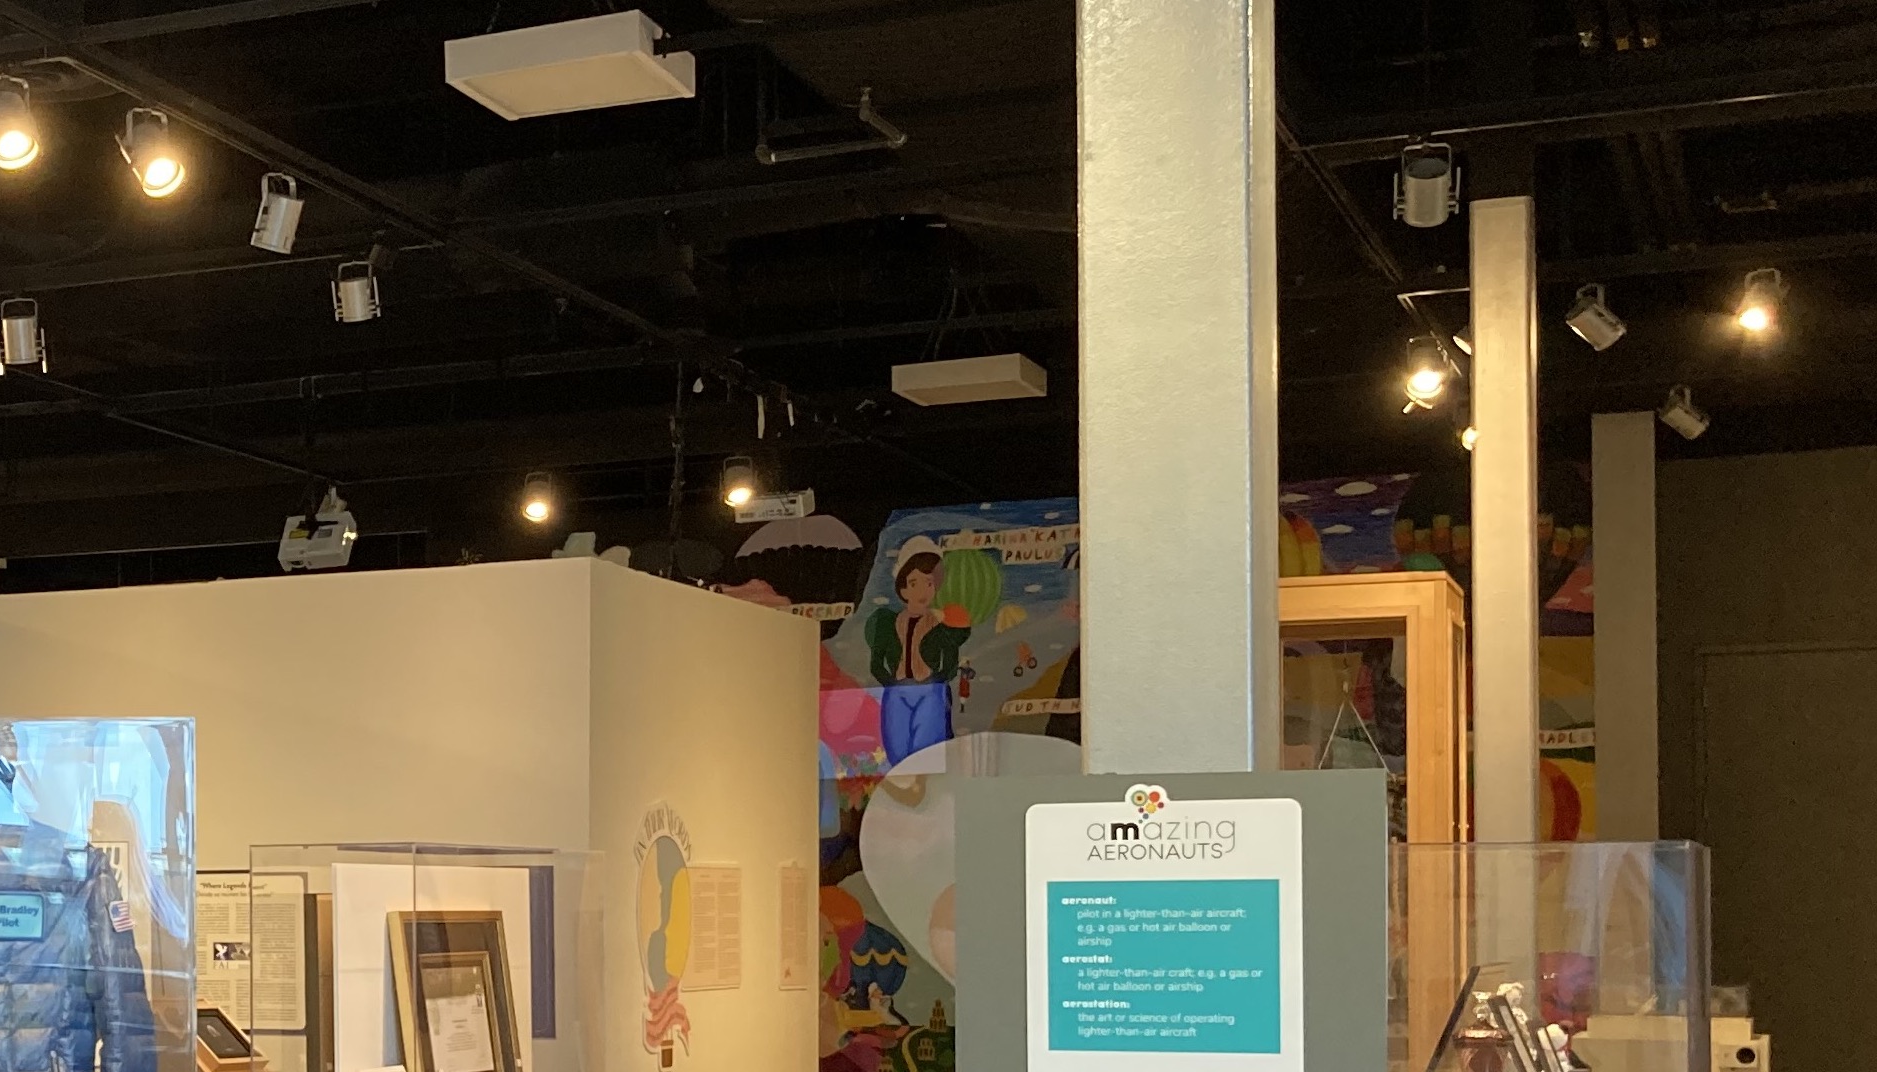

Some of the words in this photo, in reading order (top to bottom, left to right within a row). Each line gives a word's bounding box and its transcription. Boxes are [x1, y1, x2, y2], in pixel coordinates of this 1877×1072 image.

[1086, 816, 1236, 853] amazing
[1087, 843, 1223, 861] AERONAUTS
[1061, 896, 1117, 905] aeronaut:
[0, 904, 39, 916] Bradley
[1077, 908, 1100, 920] pilot
[1102, 909, 1112, 918] in
[1114, 910, 1121, 918] a
[1123, 909, 1203, 920] lighter-than-air
[1206, 908, 1247, 919] aircraft;
[1077, 924, 1095, 934] e.g.
[1098, 924, 1105, 932] a
[1107, 924, 1126, 934] gas
[1128, 924, 1140, 932] or
[1142, 922, 1160, 932] hot
[1163, 923, 1176, 932] air
[1178, 922, 1218, 932] balloon
[1219, 923, 1232, 932] or
[1077, 936, 1112, 947] airship
[1061, 954, 1113, 963] aerostat:
[1078, 969, 1084, 977] a
[1086, 968, 1165, 979] lighter-than-air
[1168, 967, 1195, 978] craft;
[1197, 969, 1216, 980] e.g.
[1219, 969, 1226, 978] a
[1228, 969, 1249, 980] gas
[1250, 969, 1263, 978] or
[1078, 981, 1095, 991] hot
[1097, 981, 1110, 991] air
[1113, 981, 1151, 991] balloon
[1154, 983, 1165, 991] or
[1167, 982, 1204, 993] airship
[1062, 1000, 1131, 1009] aerostation:
[1078, 1012, 1095, 1022] the
[1097, 1013, 1112, 1022] art
[1115, 1014, 1126, 1022] or
[1128, 1013, 1168, 1023] science
[1170, 1012, 1182, 1023] of
[1183, 1013, 1235, 1026] operating
[1078, 1026, 1157, 1038] lighter-than-air
[1160, 1027, 1197, 1037] aircraft
